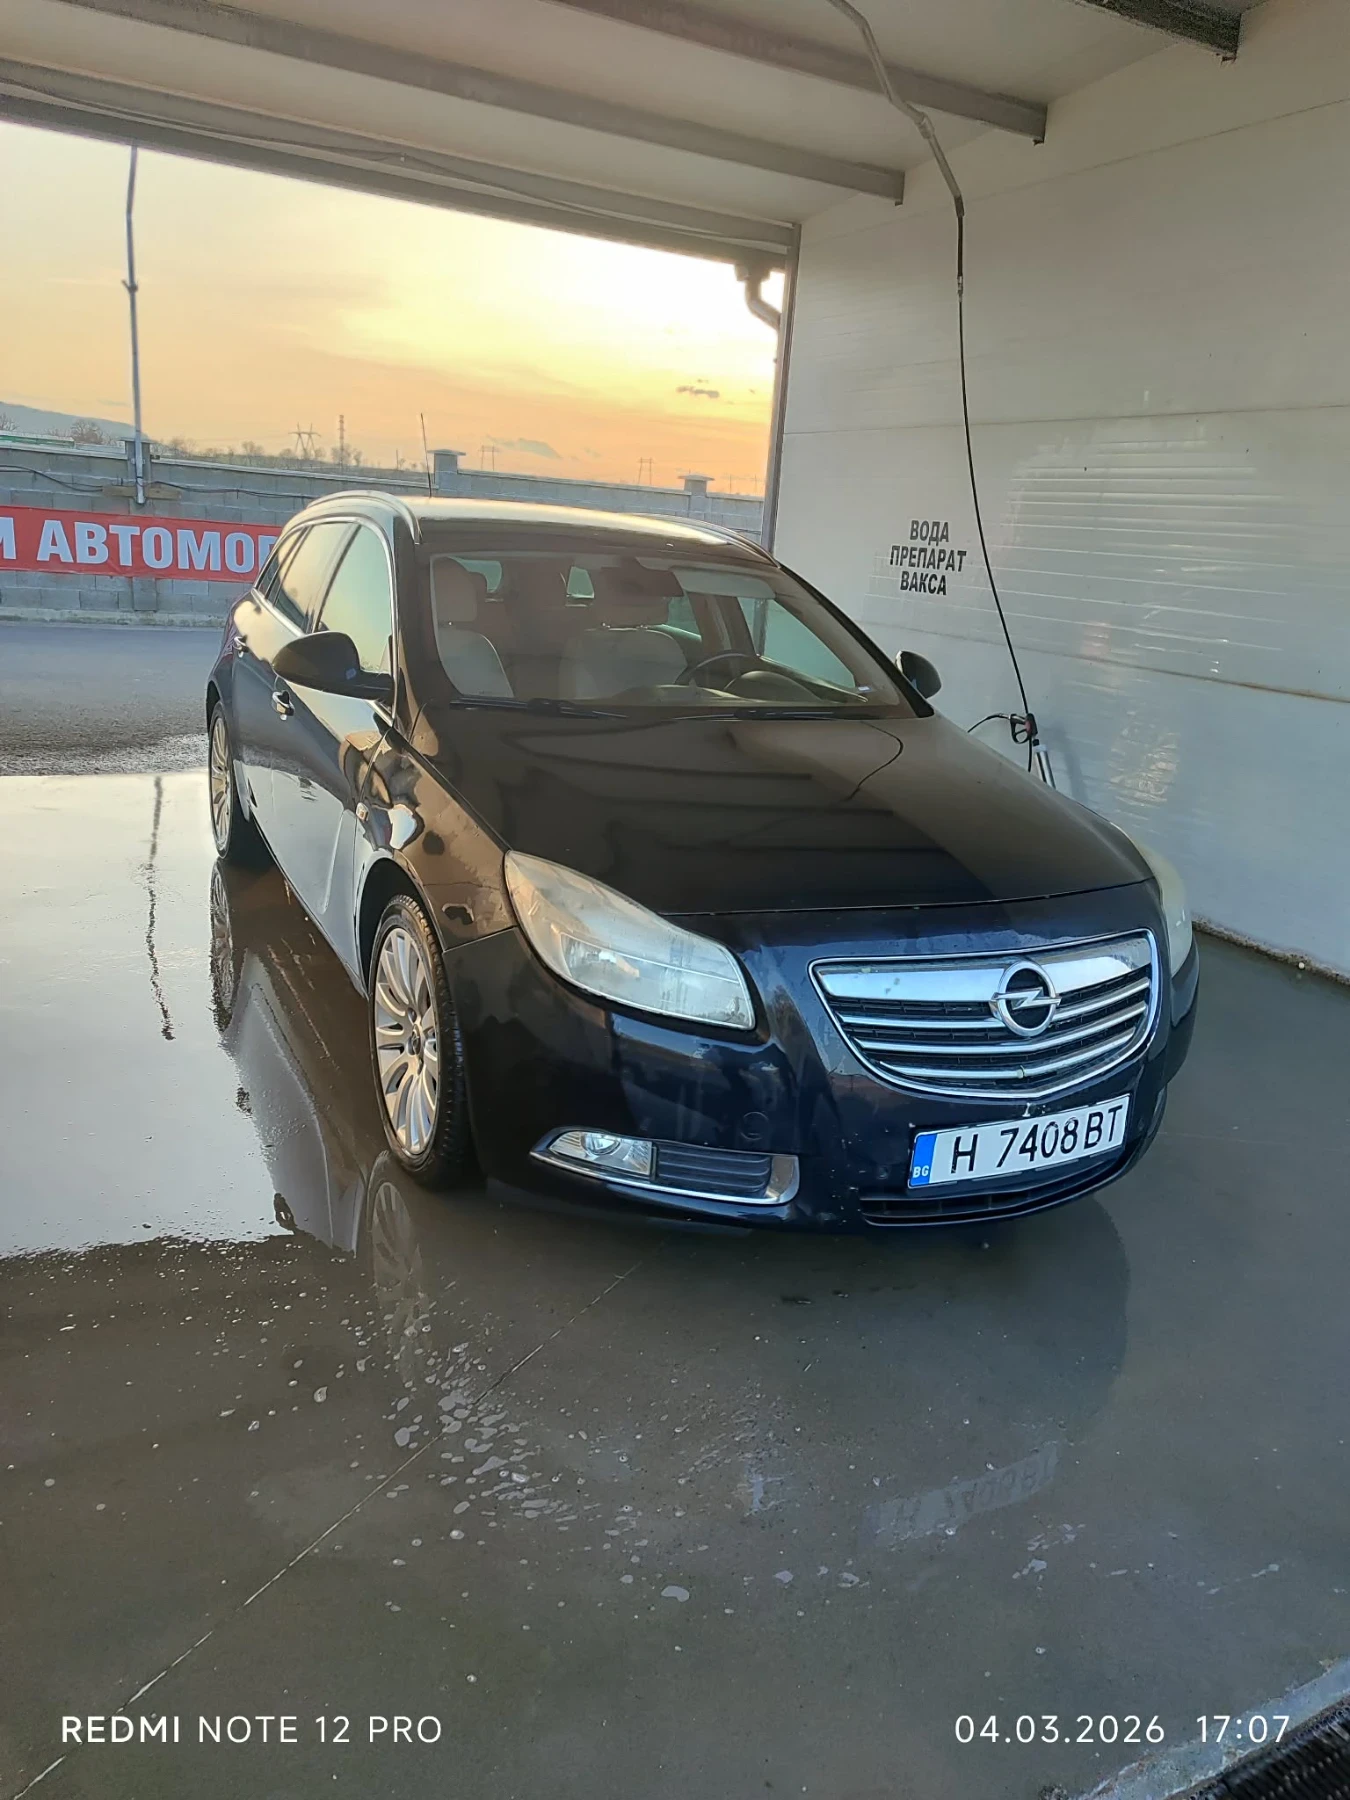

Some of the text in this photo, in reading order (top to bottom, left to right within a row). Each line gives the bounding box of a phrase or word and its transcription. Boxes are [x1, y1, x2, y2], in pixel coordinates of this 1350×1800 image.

[909, 520, 949, 546] ВОДА
[890, 545, 967, 572] ПРЕПАРАТ
[900, 571, 946, 596] ВАКСА
[951, 1134, 978, 1174] H
[913, 1165, 929, 1178] BG
